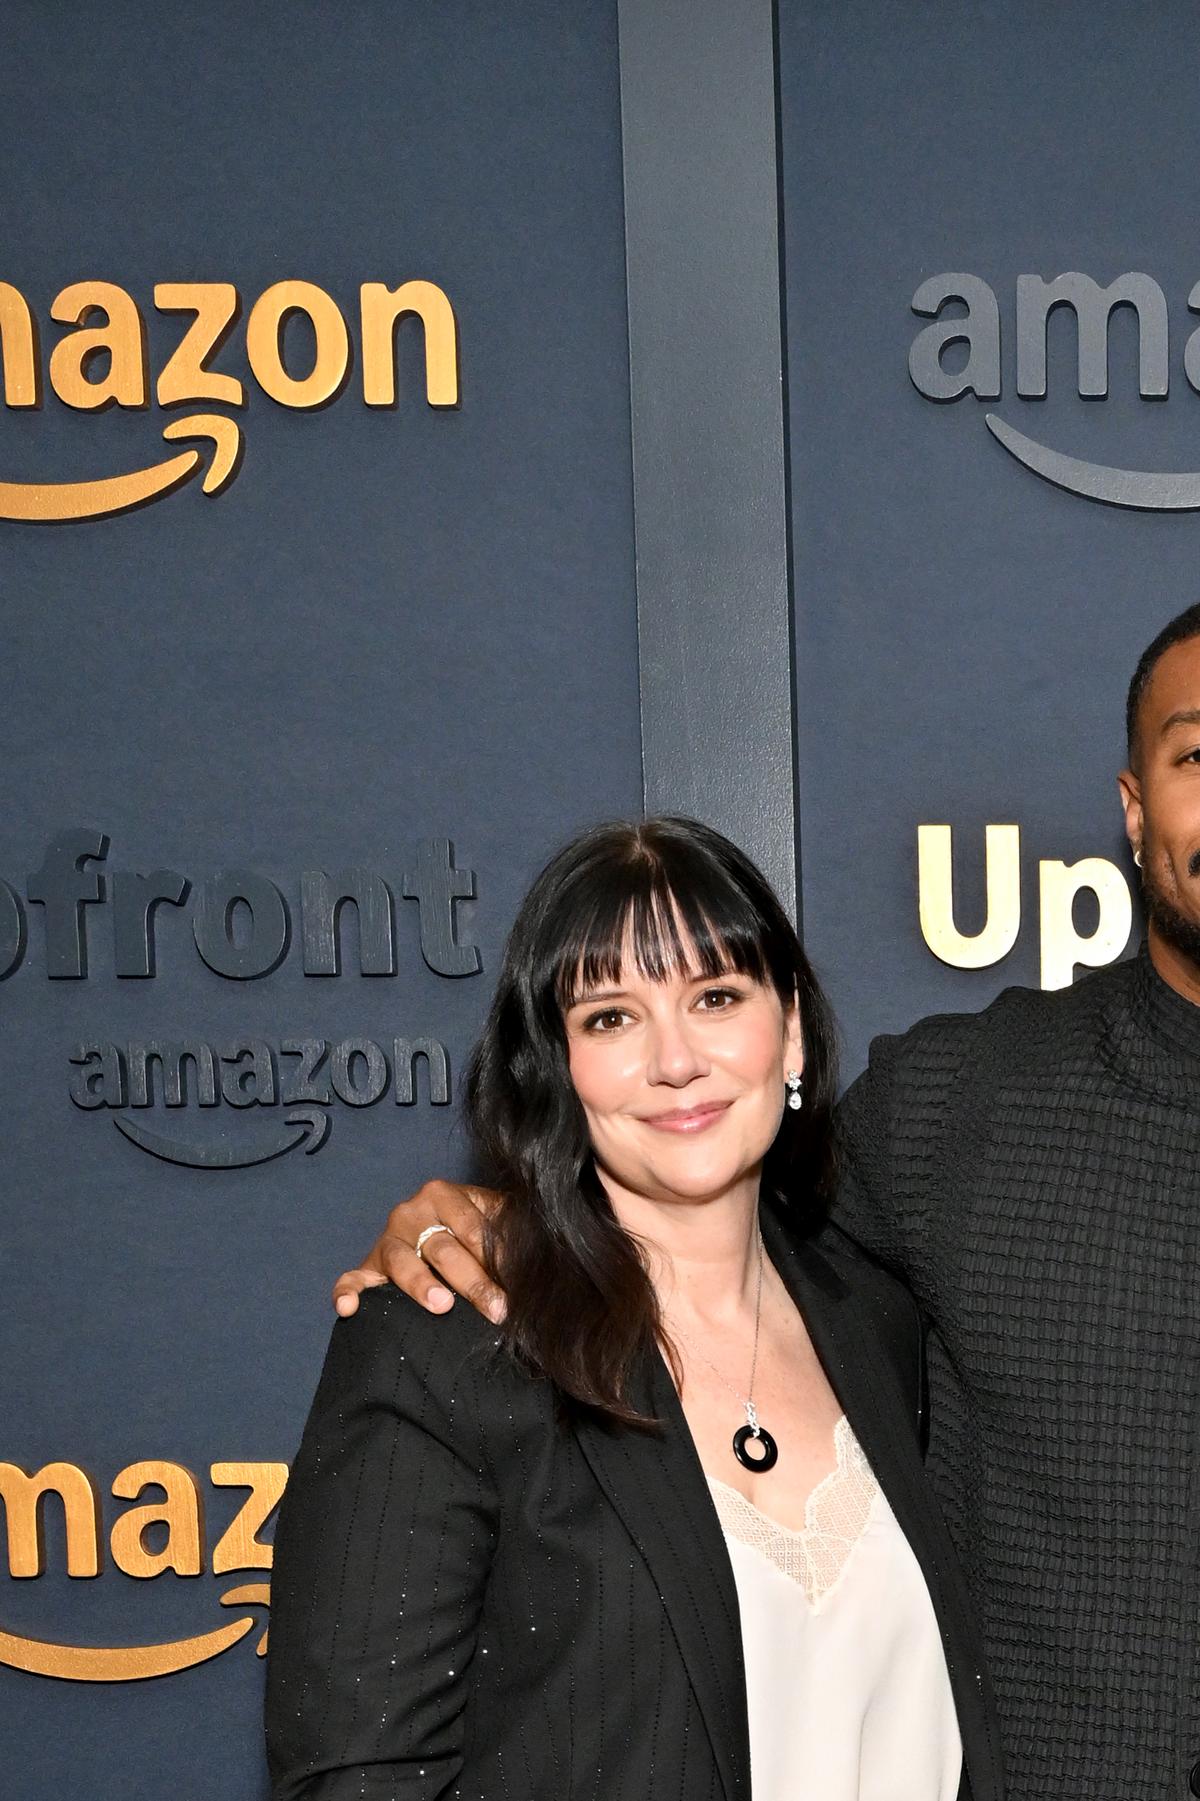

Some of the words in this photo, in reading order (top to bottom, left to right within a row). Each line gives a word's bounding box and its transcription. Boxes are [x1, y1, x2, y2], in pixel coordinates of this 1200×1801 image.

[0, 280, 460, 409] azon
[908, 271, 1200, 403] am
[0, 828, 482, 980] front
[917, 824, 1132, 991] Up
[69, 1038, 450, 1110] amazon
